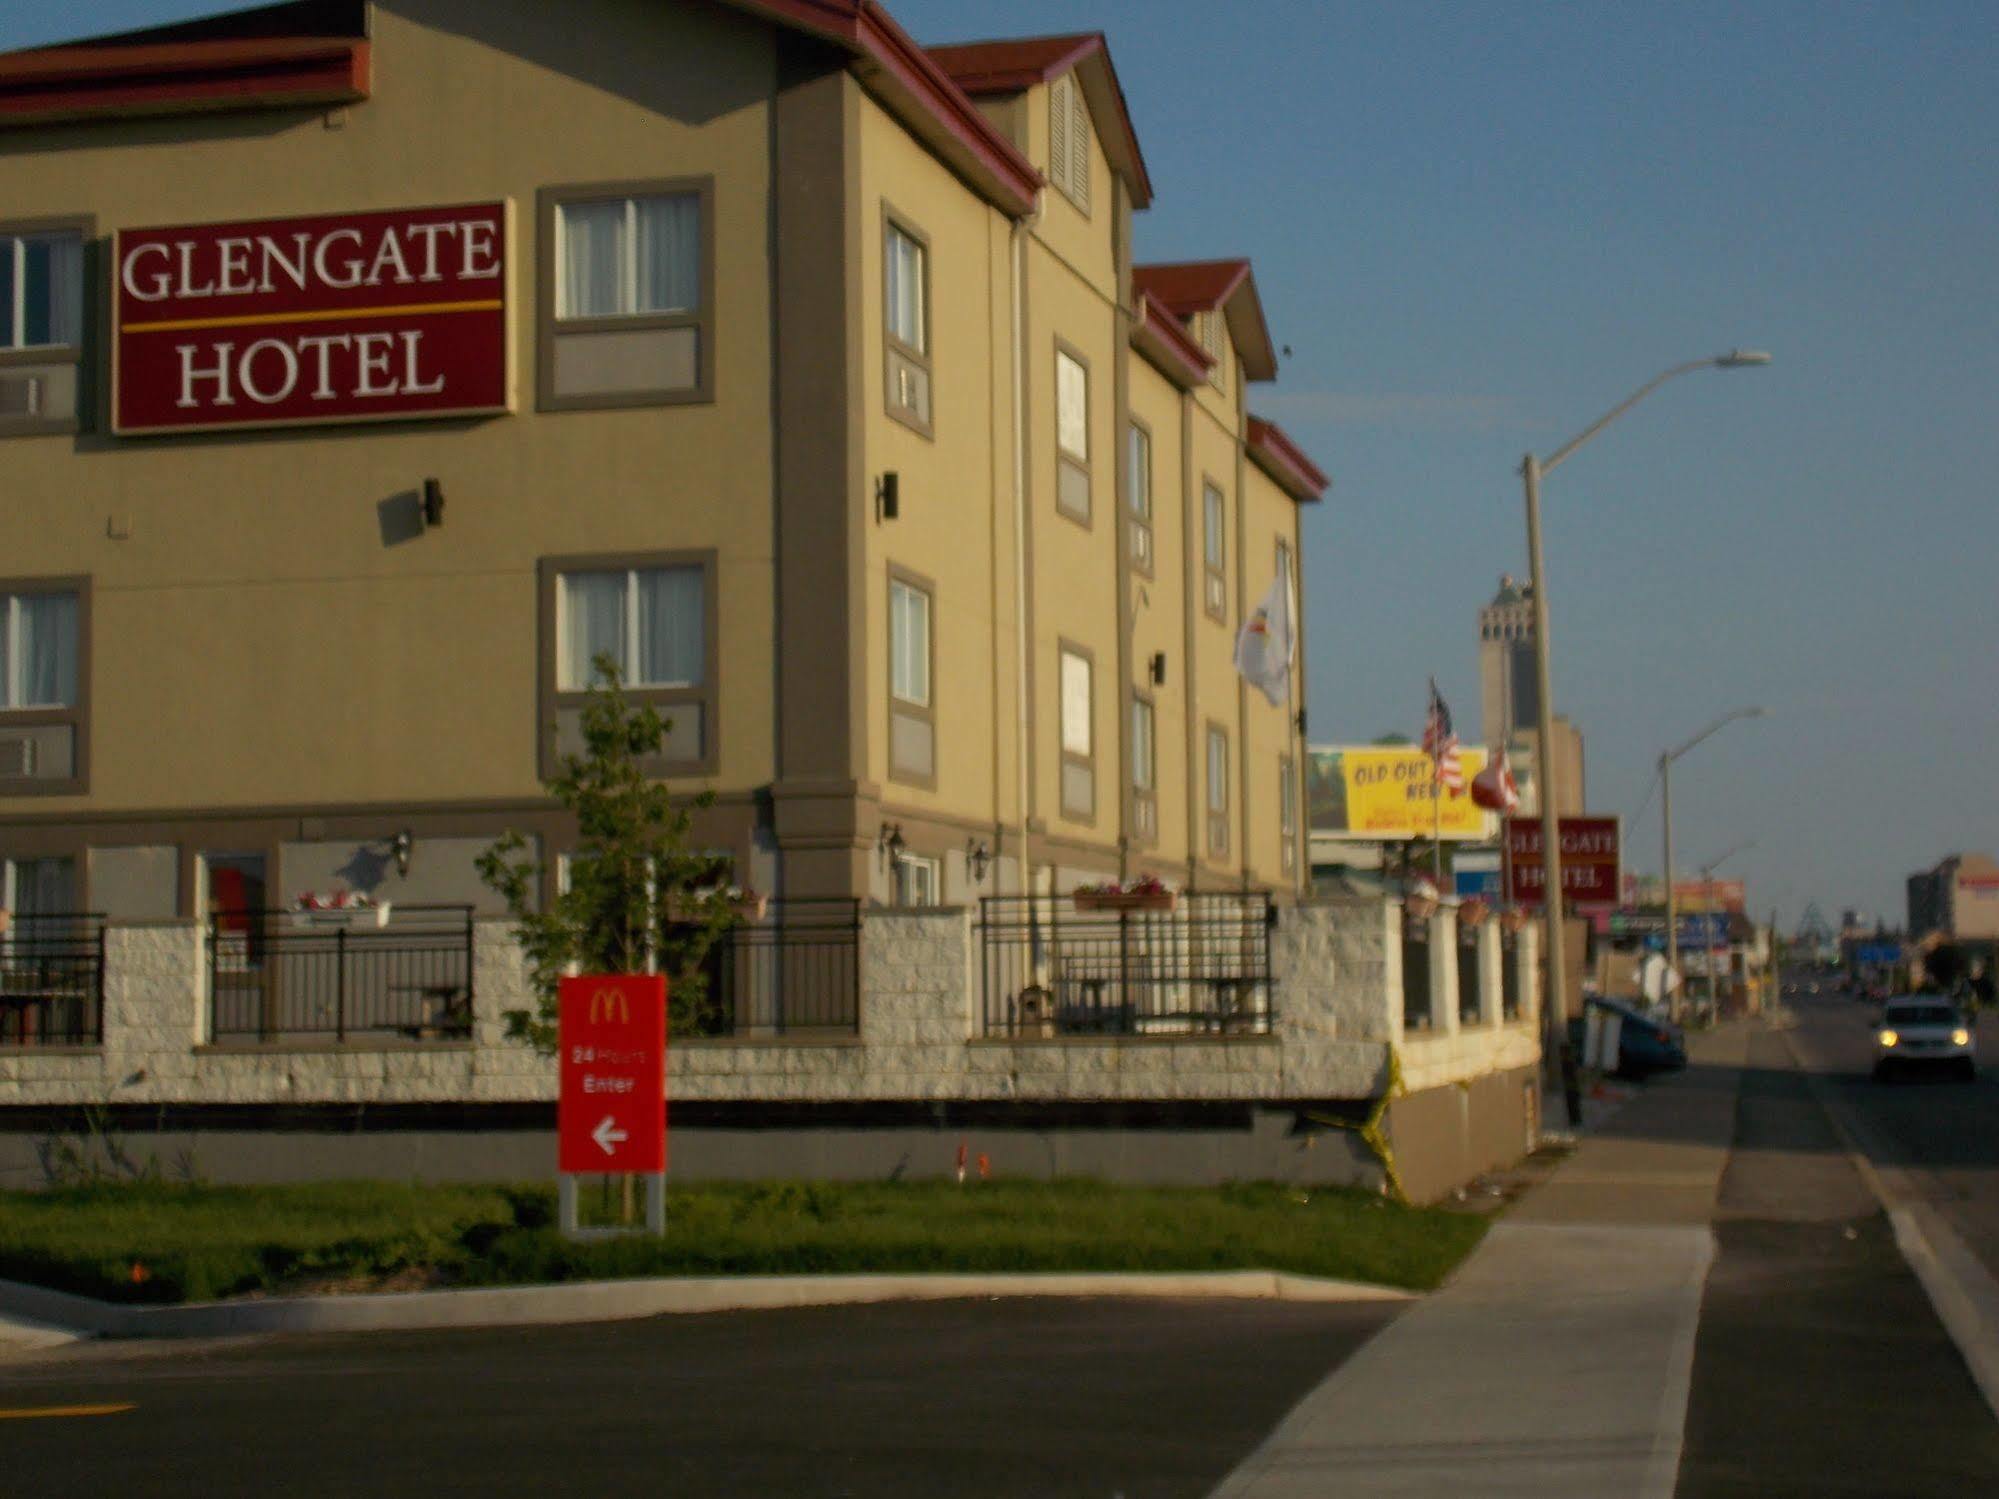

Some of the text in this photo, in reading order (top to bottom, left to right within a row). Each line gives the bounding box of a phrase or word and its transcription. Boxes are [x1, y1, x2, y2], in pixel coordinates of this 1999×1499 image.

[121, 219, 501, 302] GLENGATE
[175, 330, 446, 408] HOTEL
[1354, 764, 1388, 787] OLD
[571, 1046, 595, 1064] 24
[583, 1074, 635, 1094] Enter
